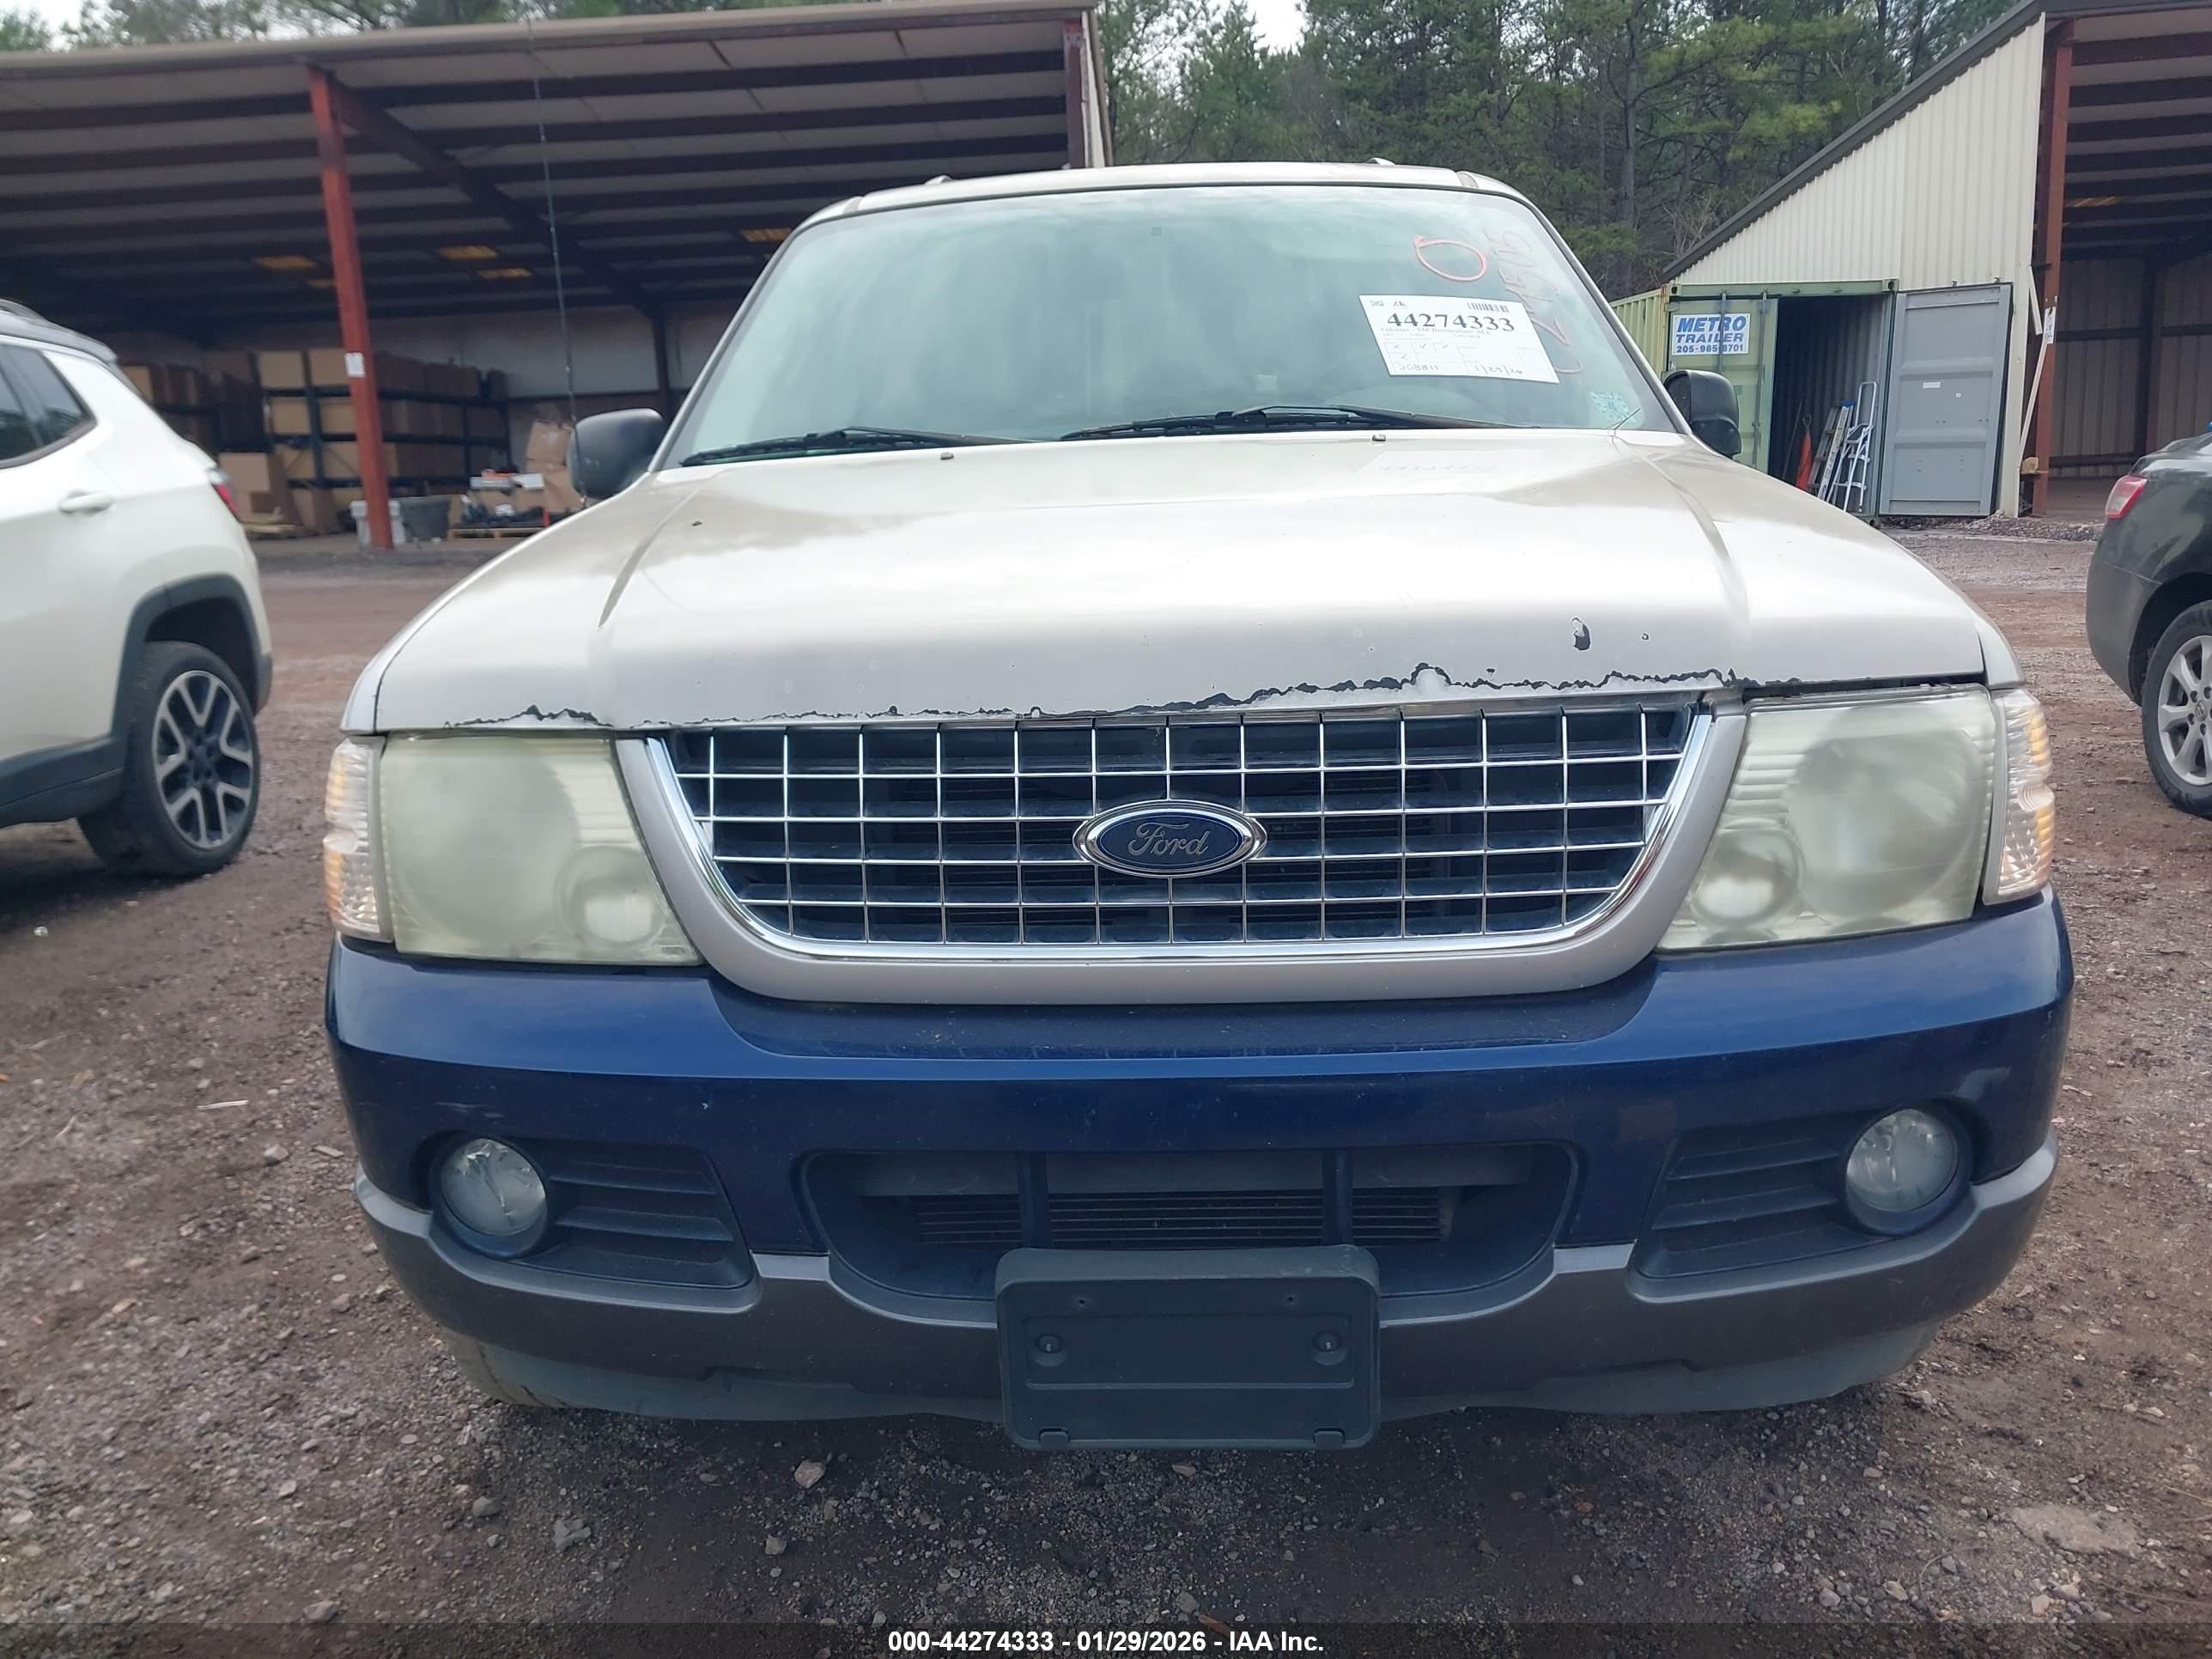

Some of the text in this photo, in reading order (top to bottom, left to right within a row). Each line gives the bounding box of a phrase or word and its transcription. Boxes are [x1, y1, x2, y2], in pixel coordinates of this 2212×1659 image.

[1388, 313, 1515, 331] 44274333
[1677, 315, 1747, 332] METRO
[1675, 333, 1744, 343] TRAILER
[1127, 822, 1211, 856] Ford
